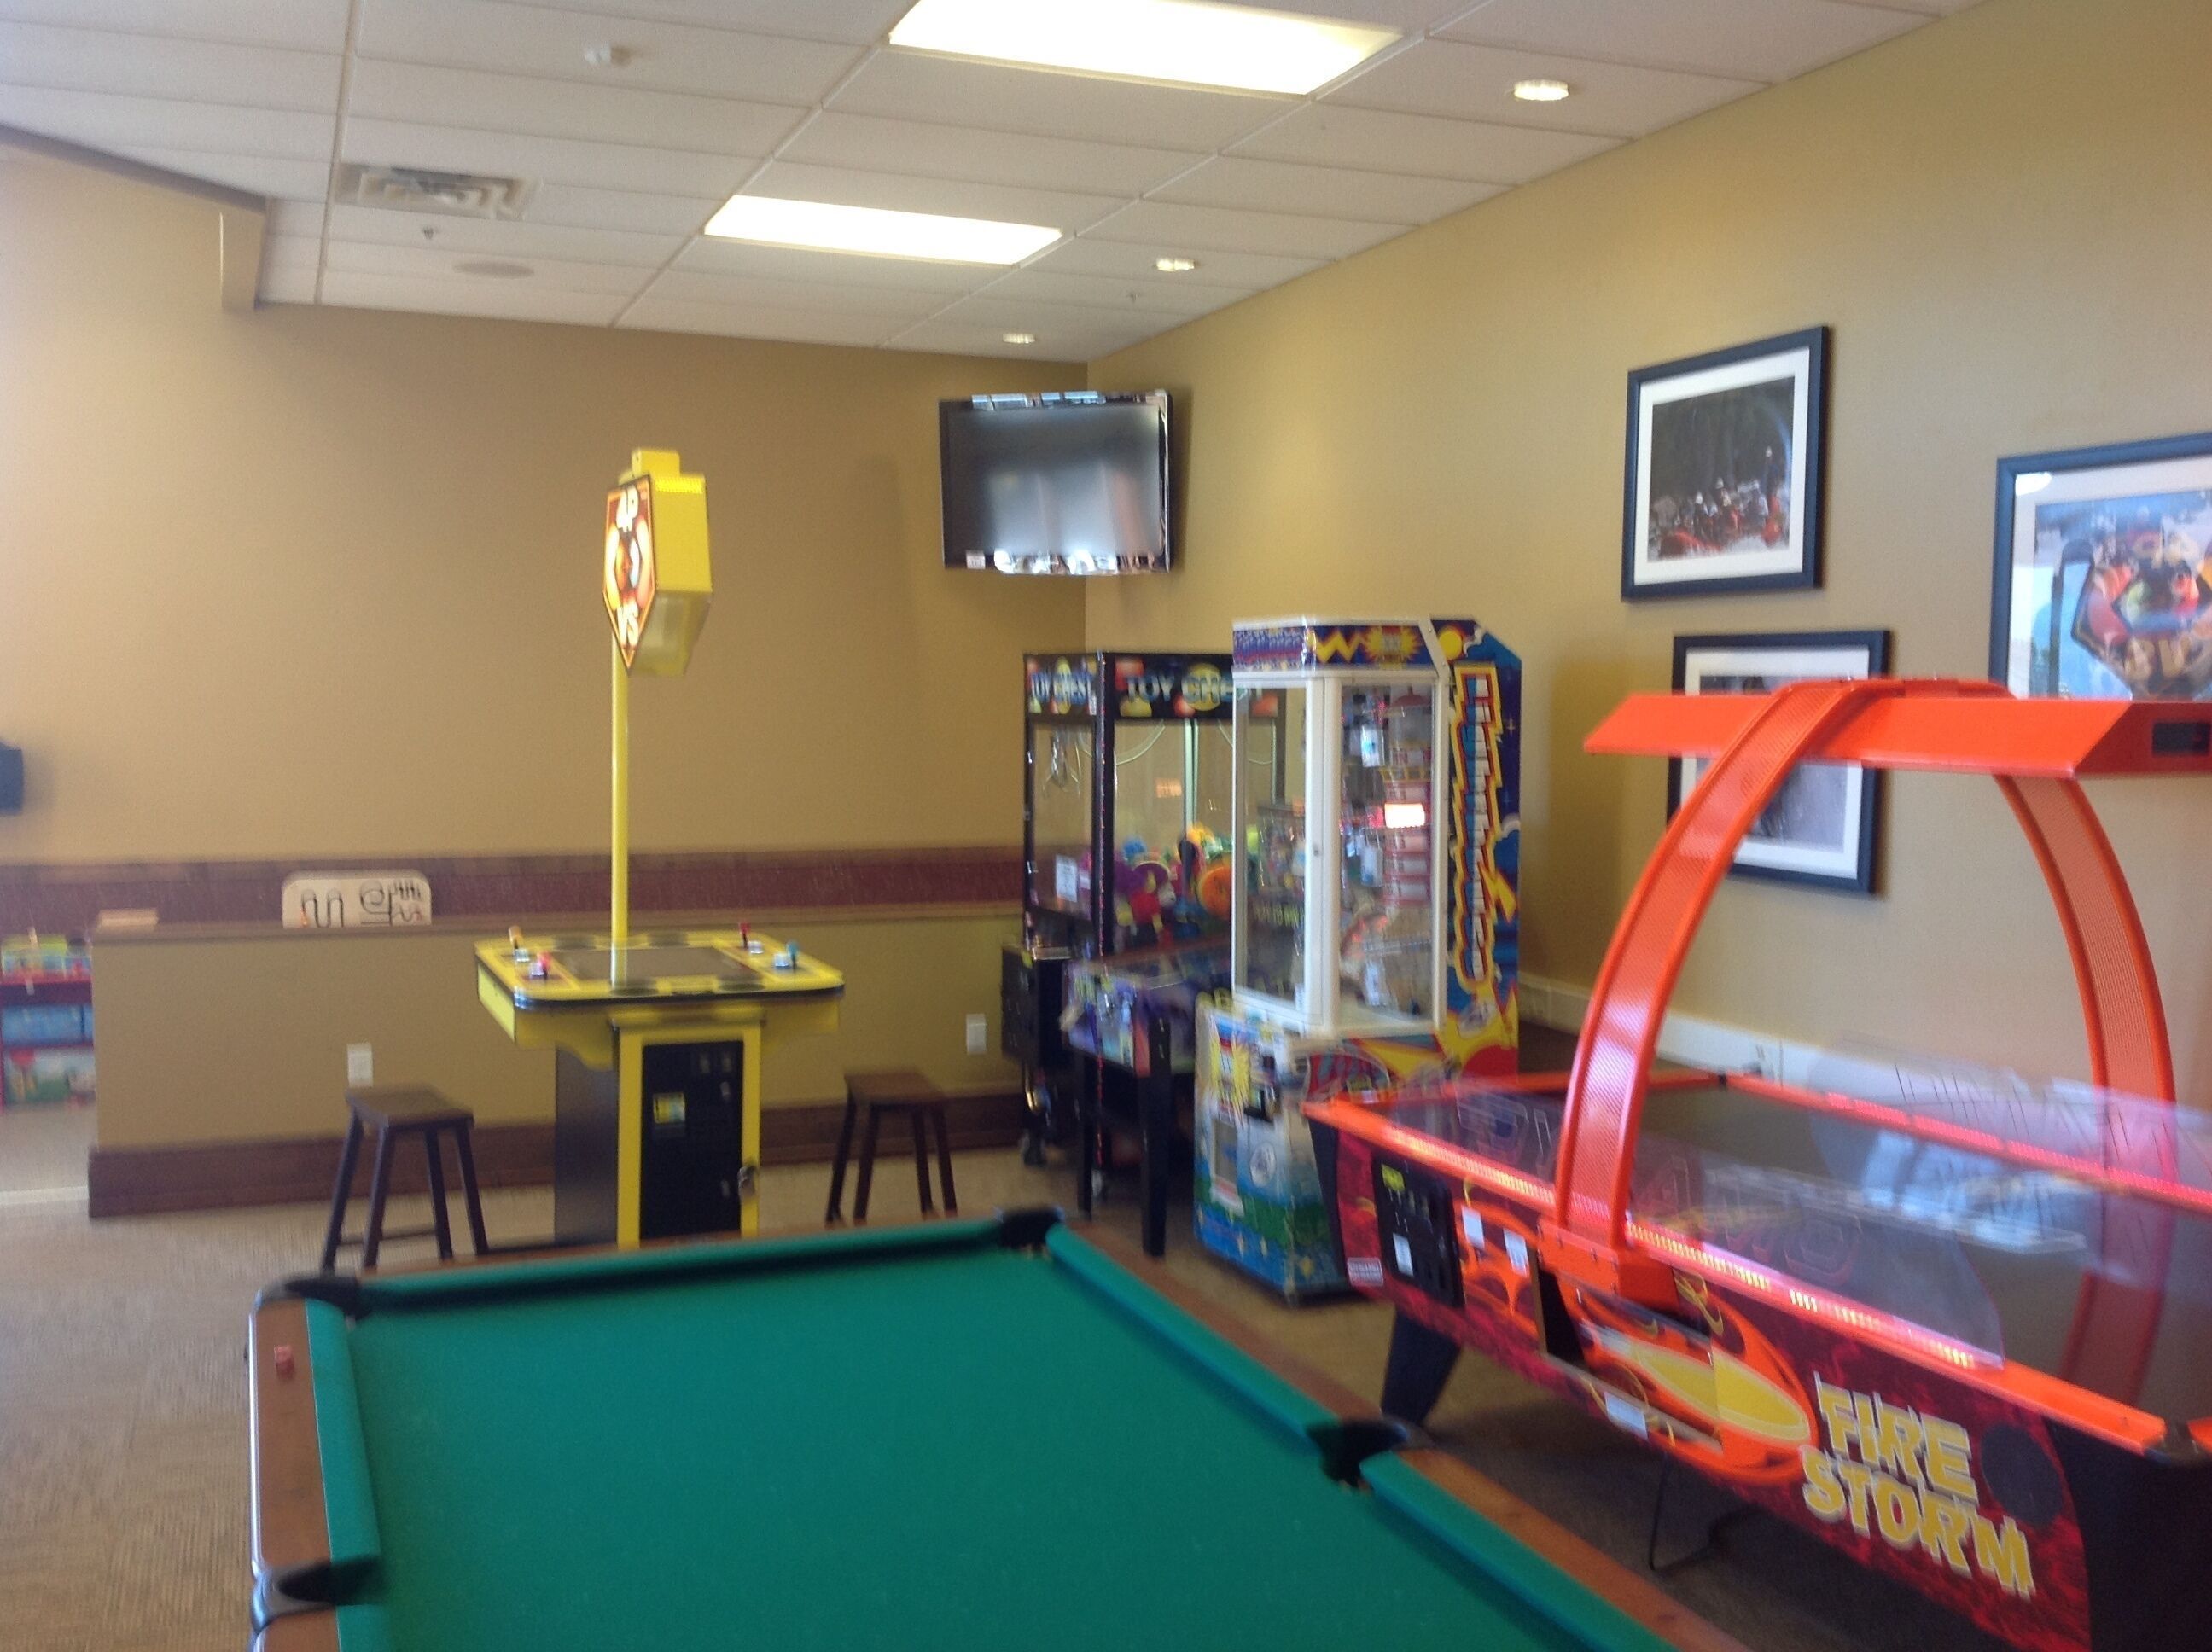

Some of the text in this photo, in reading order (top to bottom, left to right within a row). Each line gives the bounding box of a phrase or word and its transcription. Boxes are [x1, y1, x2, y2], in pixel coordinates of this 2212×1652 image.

[616, 599, 640, 647] VS
[1126, 673, 1175, 703] TOY
[1814, 1370, 1979, 1507] FIRE
[1799, 1445, 2036, 1602] STORM
